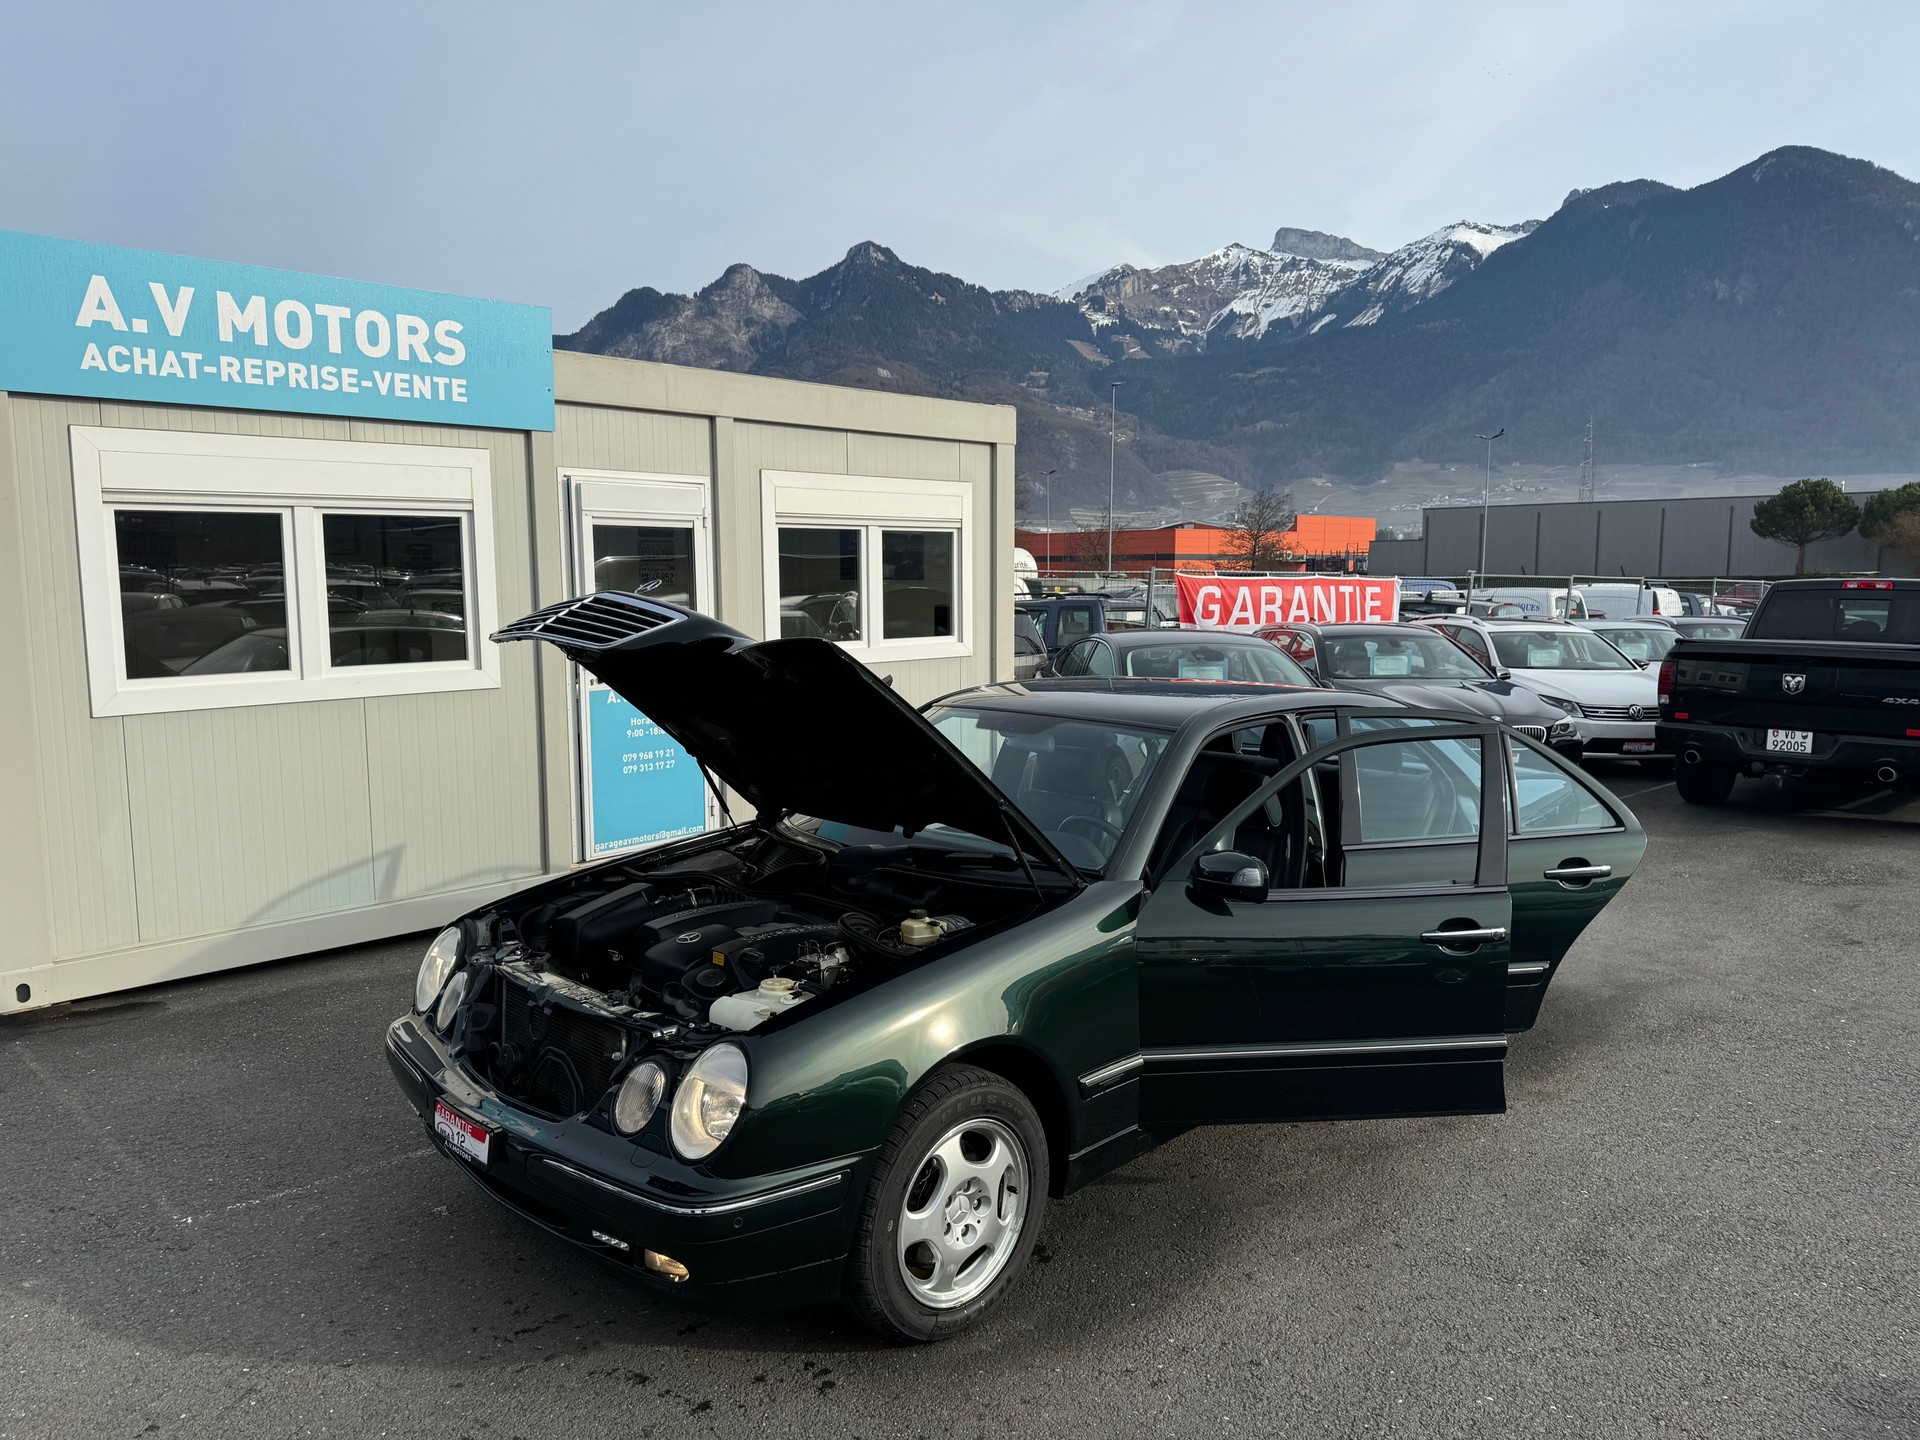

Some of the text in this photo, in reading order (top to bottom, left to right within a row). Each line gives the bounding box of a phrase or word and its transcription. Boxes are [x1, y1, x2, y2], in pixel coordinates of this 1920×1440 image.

[75, 274, 466, 366] A.V MOTORS
[80, 342, 468, 403] ACHAT-REPRISE-VENTE
[1193, 584, 1382, 627] GARANTIE
[1518, 602, 1540, 613] QUES
[626, 729, 644, 738] 9:00
[1784, 731, 1796, 740] VD
[1772, 739, 1807, 752] 92005
[623, 748, 674, 762] 079 968 19 21
[623, 760, 675, 774] 079 313 17 27
[595, 825, 704, 853] garageavmotors@gmail.com
[436, 1103, 472, 1136] GARANTIE
[456, 1131, 466, 1149] 12
